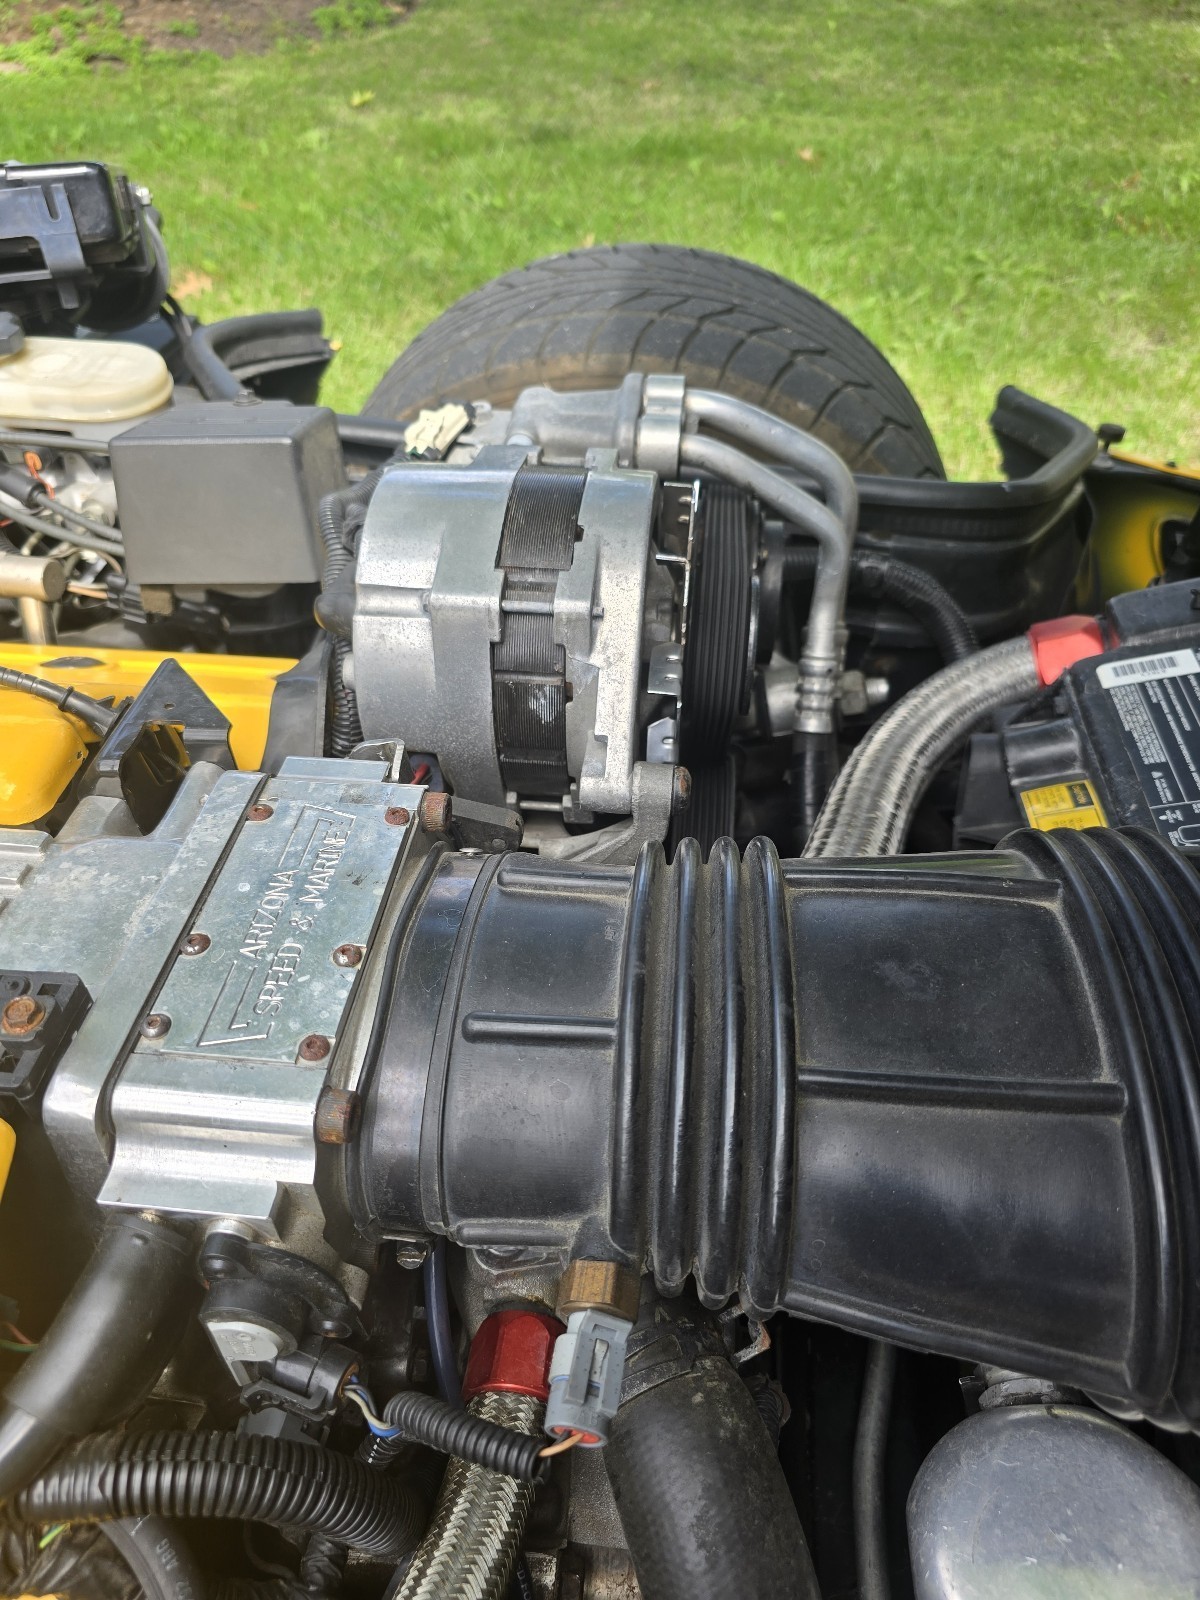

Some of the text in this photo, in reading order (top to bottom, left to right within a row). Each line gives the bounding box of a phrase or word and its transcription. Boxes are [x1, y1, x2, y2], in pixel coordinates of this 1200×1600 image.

[240, 869, 300, 960] ARIZONA
[253, 830, 351, 1017] SPEED & MARINE
